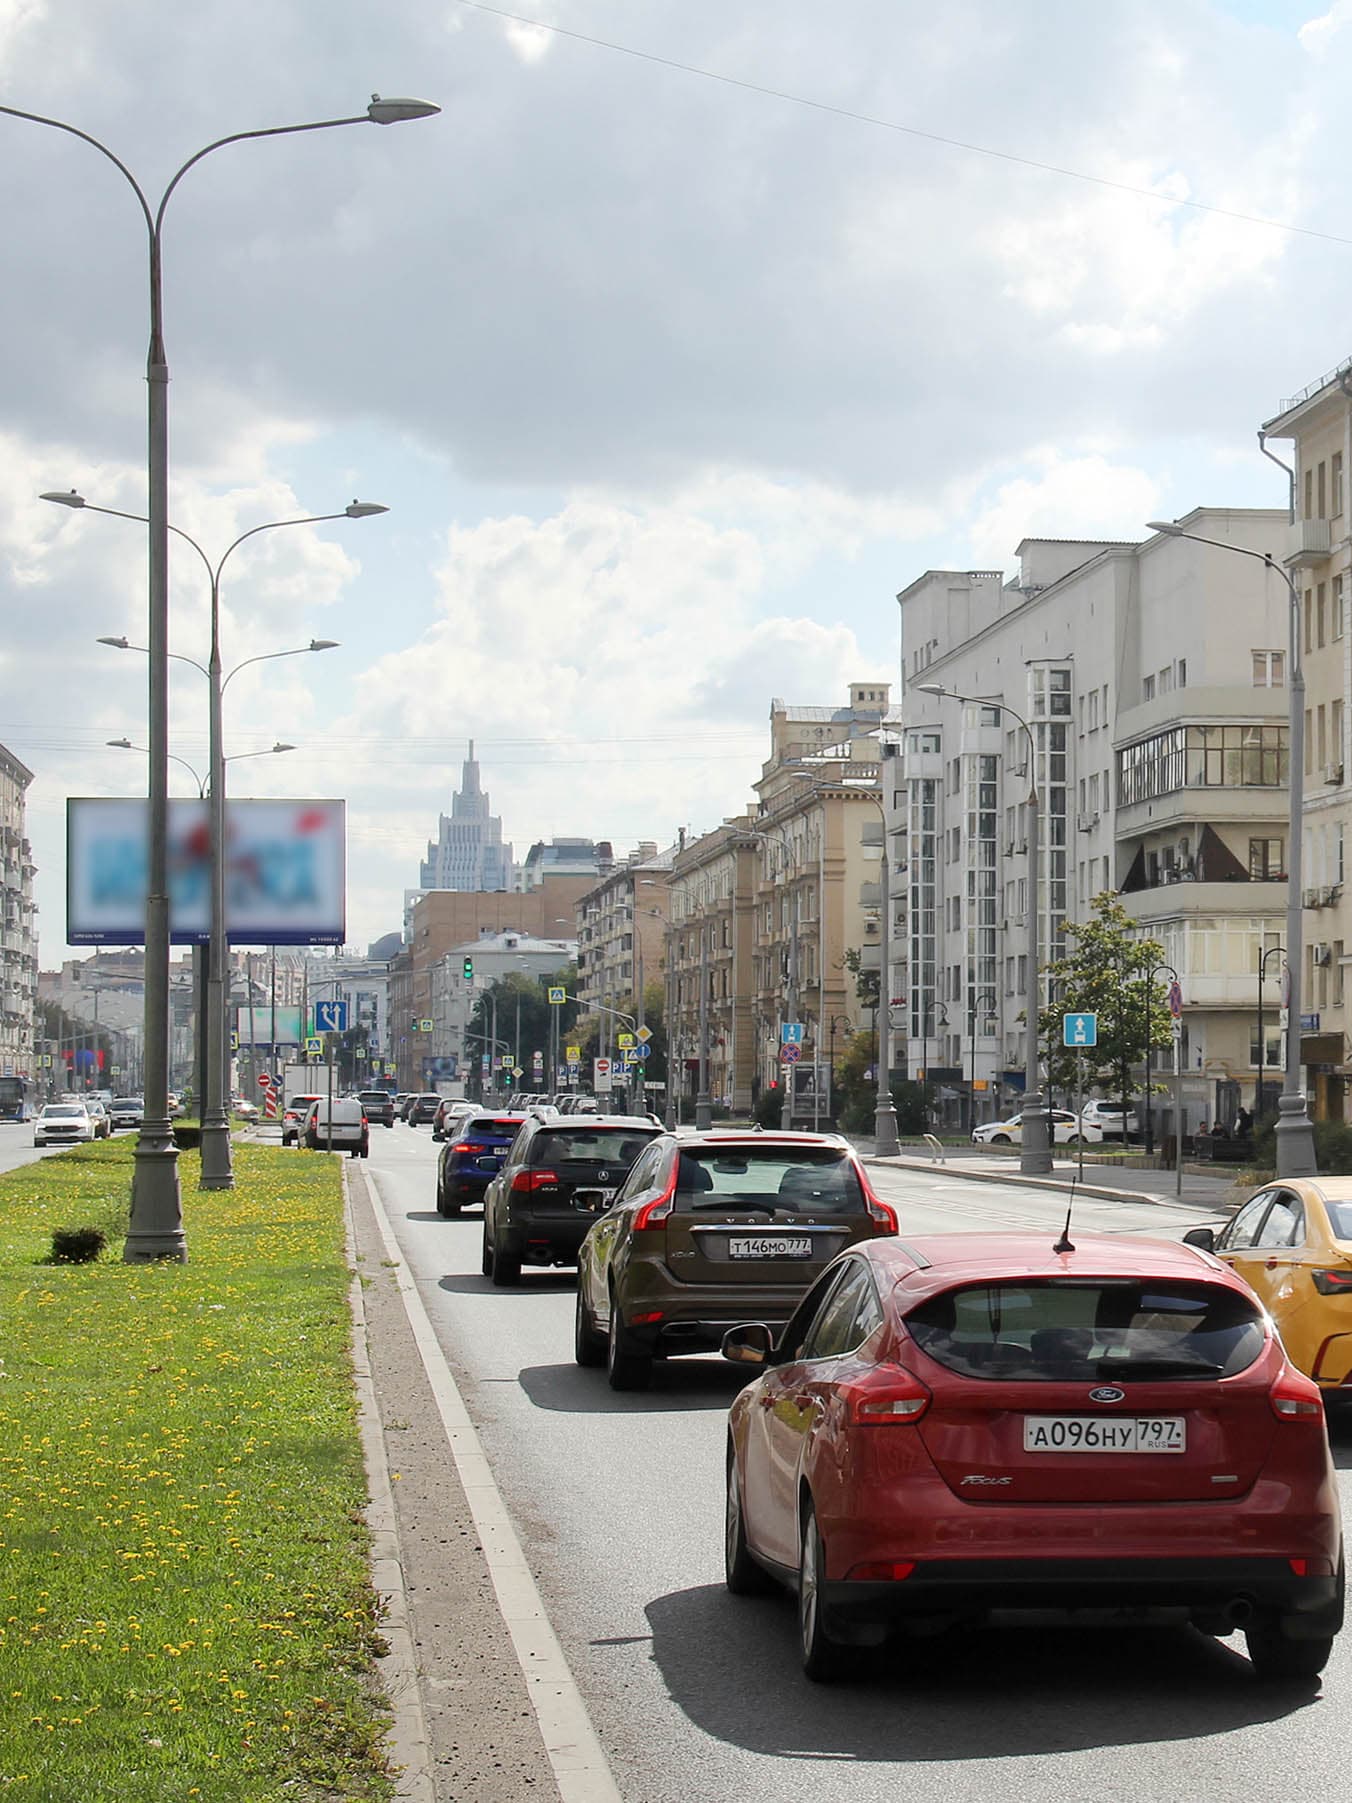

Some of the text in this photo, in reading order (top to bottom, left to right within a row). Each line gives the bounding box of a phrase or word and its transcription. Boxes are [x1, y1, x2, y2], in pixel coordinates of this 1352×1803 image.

[787, 1240, 808, 1249] 777
[1034, 1421, 1177, 1447] А096НУ 797
[1147, 1440, 1167, 1448] RUS
